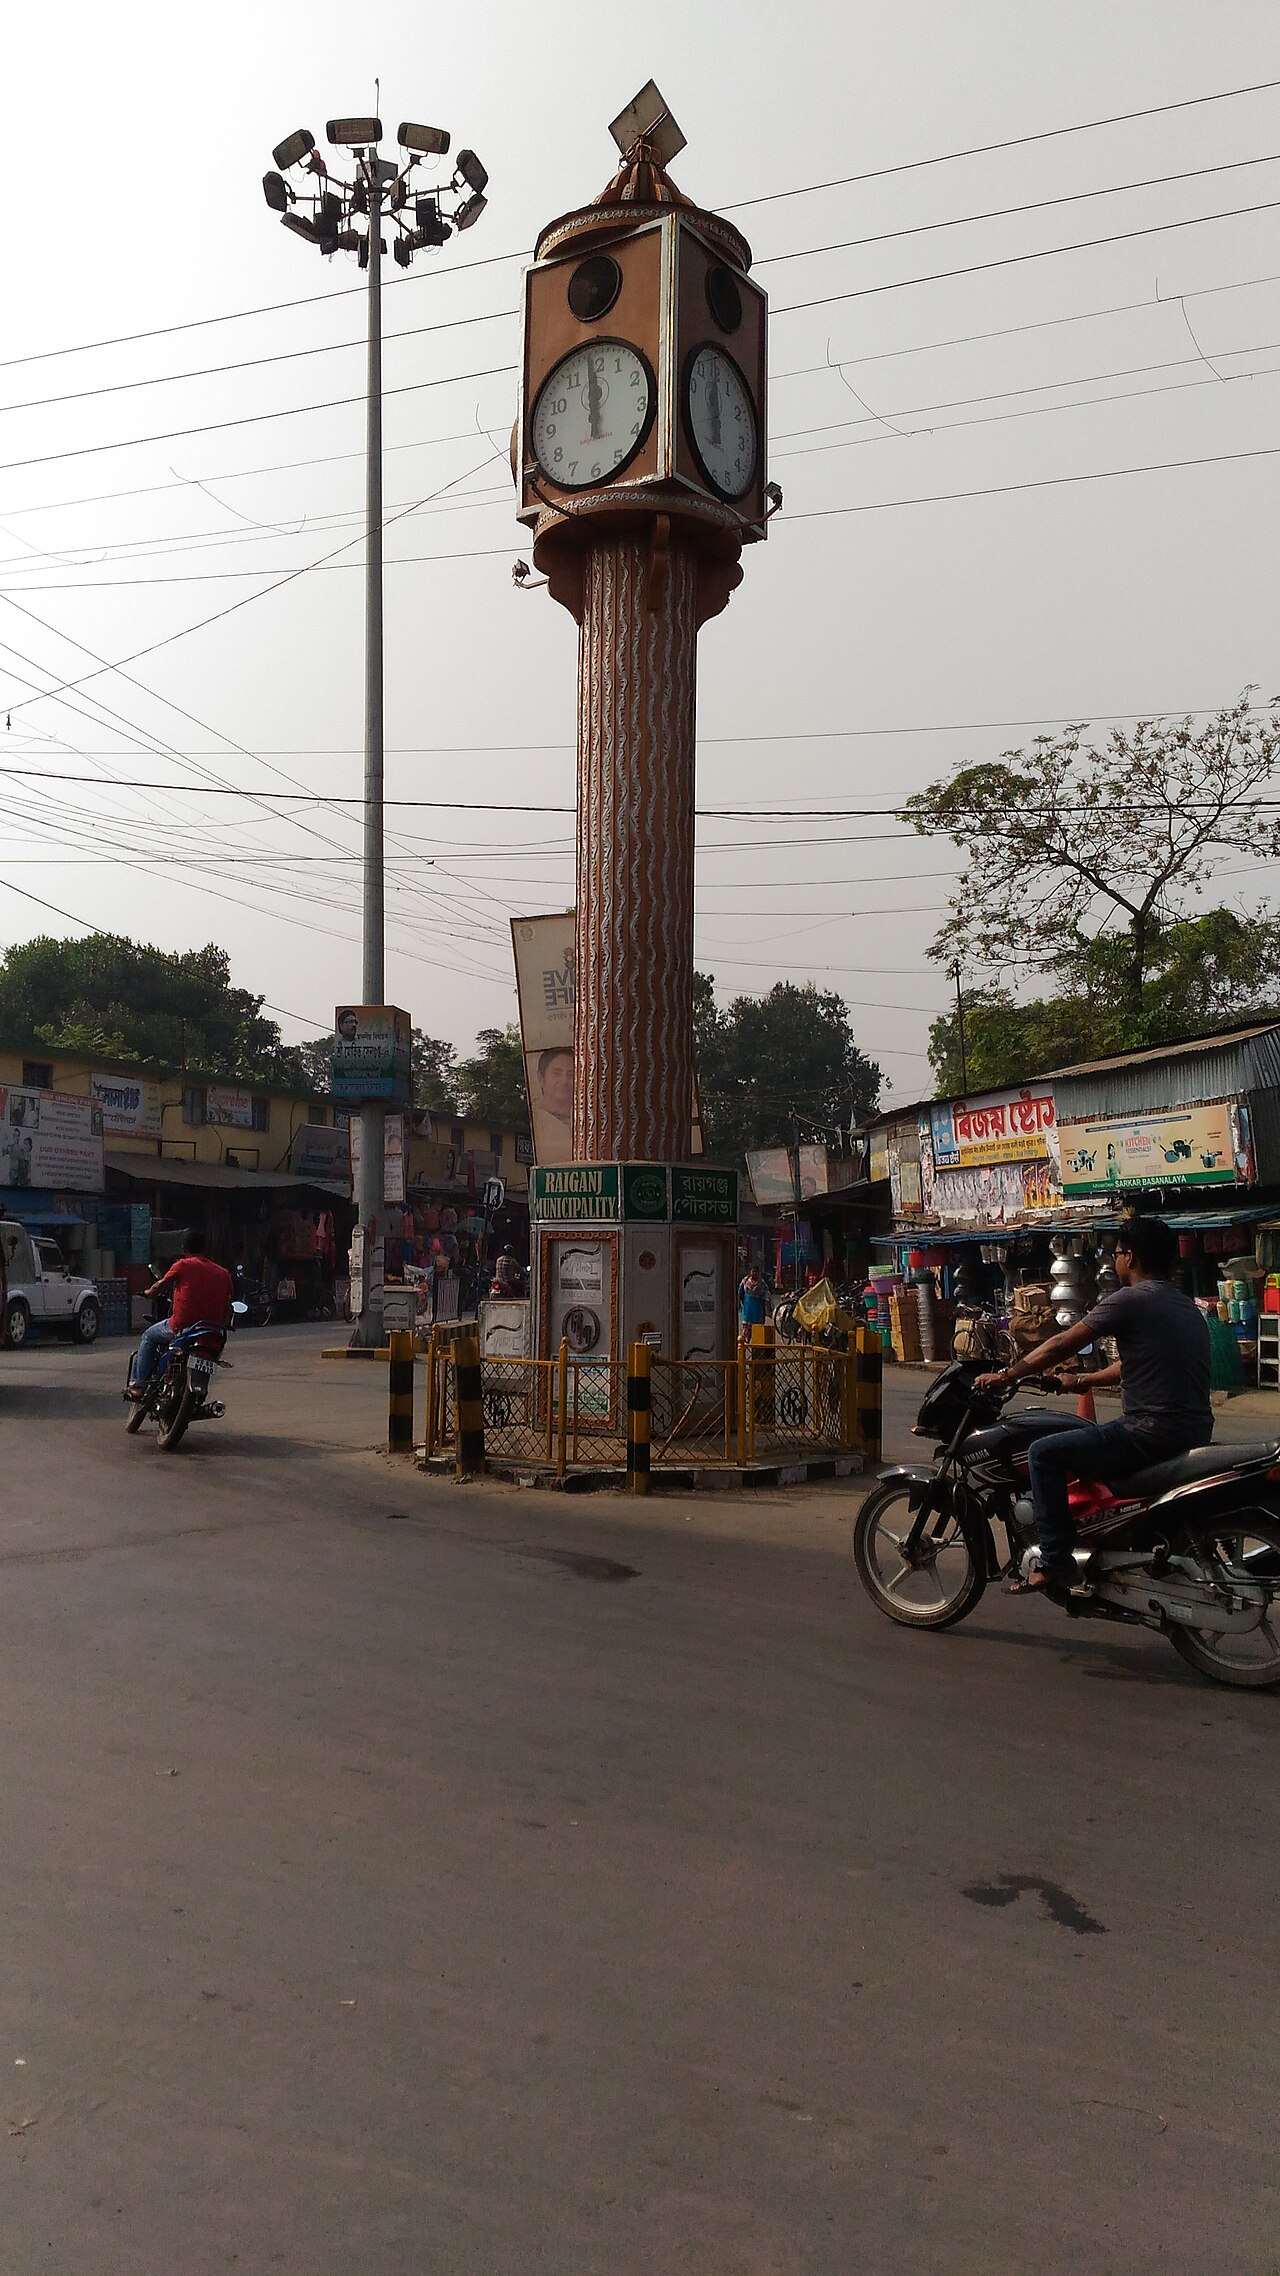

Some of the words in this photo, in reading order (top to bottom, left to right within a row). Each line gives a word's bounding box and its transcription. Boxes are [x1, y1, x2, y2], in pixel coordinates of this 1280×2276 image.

[614, 358, 623, 373] 1
[566, 372, 581, 390] 11
[630, 370, 640, 387] 2
[725, 381, 731, 397] 1
[550, 398, 567, 416] 10
[637, 396, 647, 412] 3
[734, 406, 742, 422] 2
[546, 424, 556, 440] 9
[631, 422, 640, 437] 4
[738, 435, 746, 451] 3
[553, 447, 563, 462] 8
[613, 448, 623, 465] 5
[568, 461, 579, 477] 7
[590, 462, 602, 479] 6
[953, 1102, 1007, 1143] বিজয়
[1125, 1136, 1151, 1147] KITCHEN
[545, 1170, 603, 1195] RAIGANJ
[680, 1175, 729, 1196] রায়গঞ্জ
[1115, 1179, 1141, 1188] SARKAR
[1142, 1175, 1187, 1186] BASANALAYA
[535, 1196, 616, 1219] MUNICIPALITY
[674, 1193, 733, 1216] পৌরসভা
[963, 1448, 990, 1464] YAMAHA
